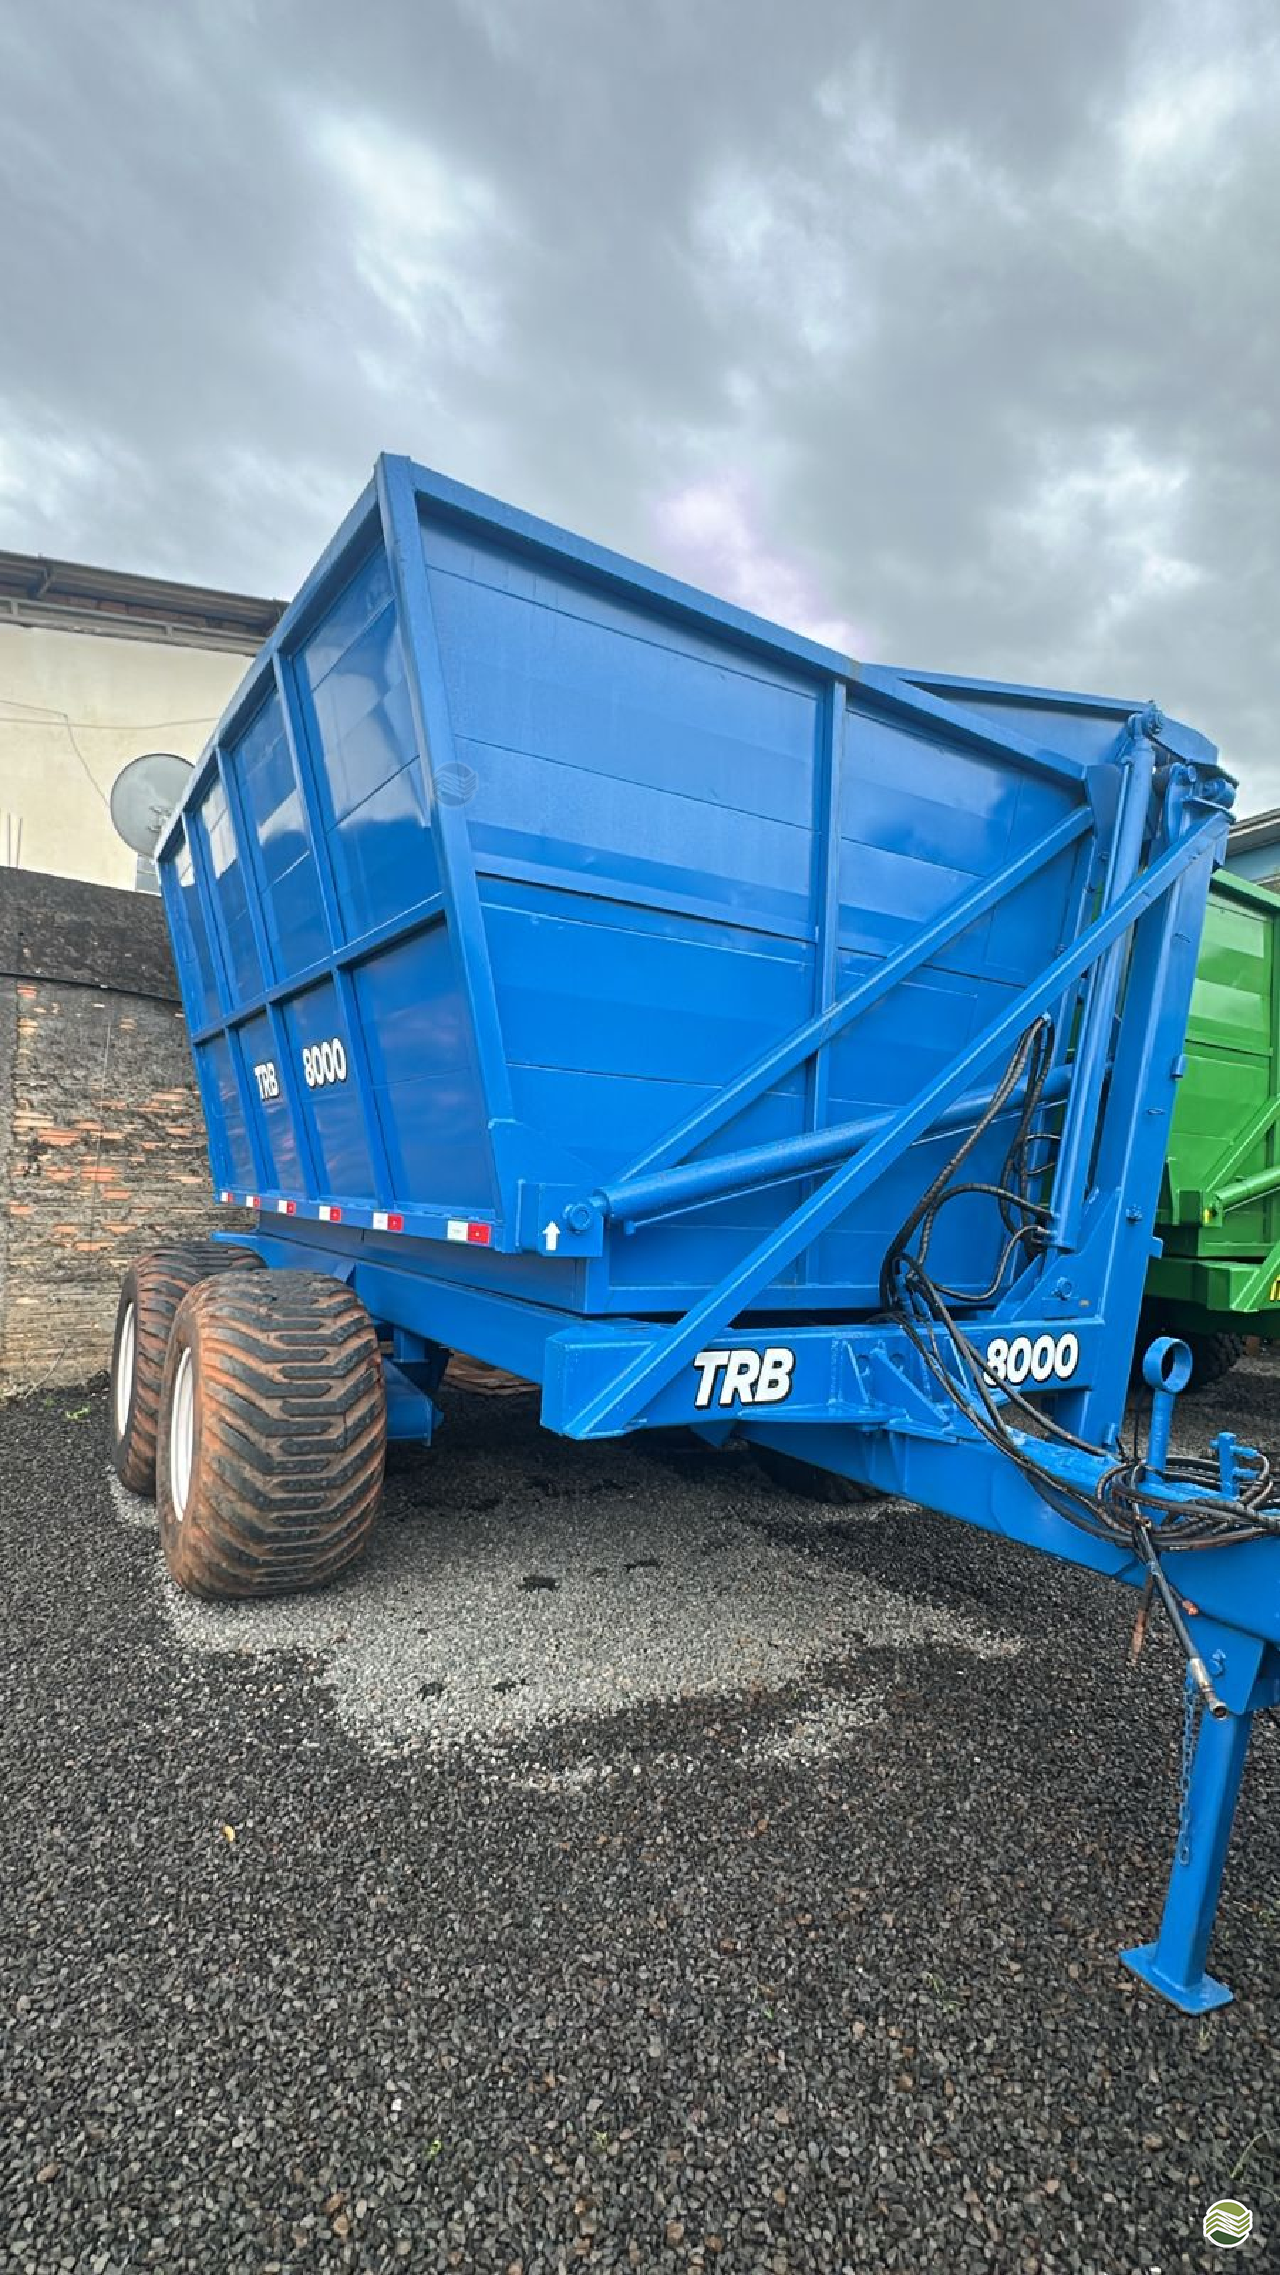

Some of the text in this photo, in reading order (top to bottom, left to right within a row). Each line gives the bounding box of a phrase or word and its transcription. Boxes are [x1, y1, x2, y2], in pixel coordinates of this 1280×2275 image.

[254, 1037, 347, 1100] TRB 8000
[693, 1332, 1080, 1408] TRB 8000
